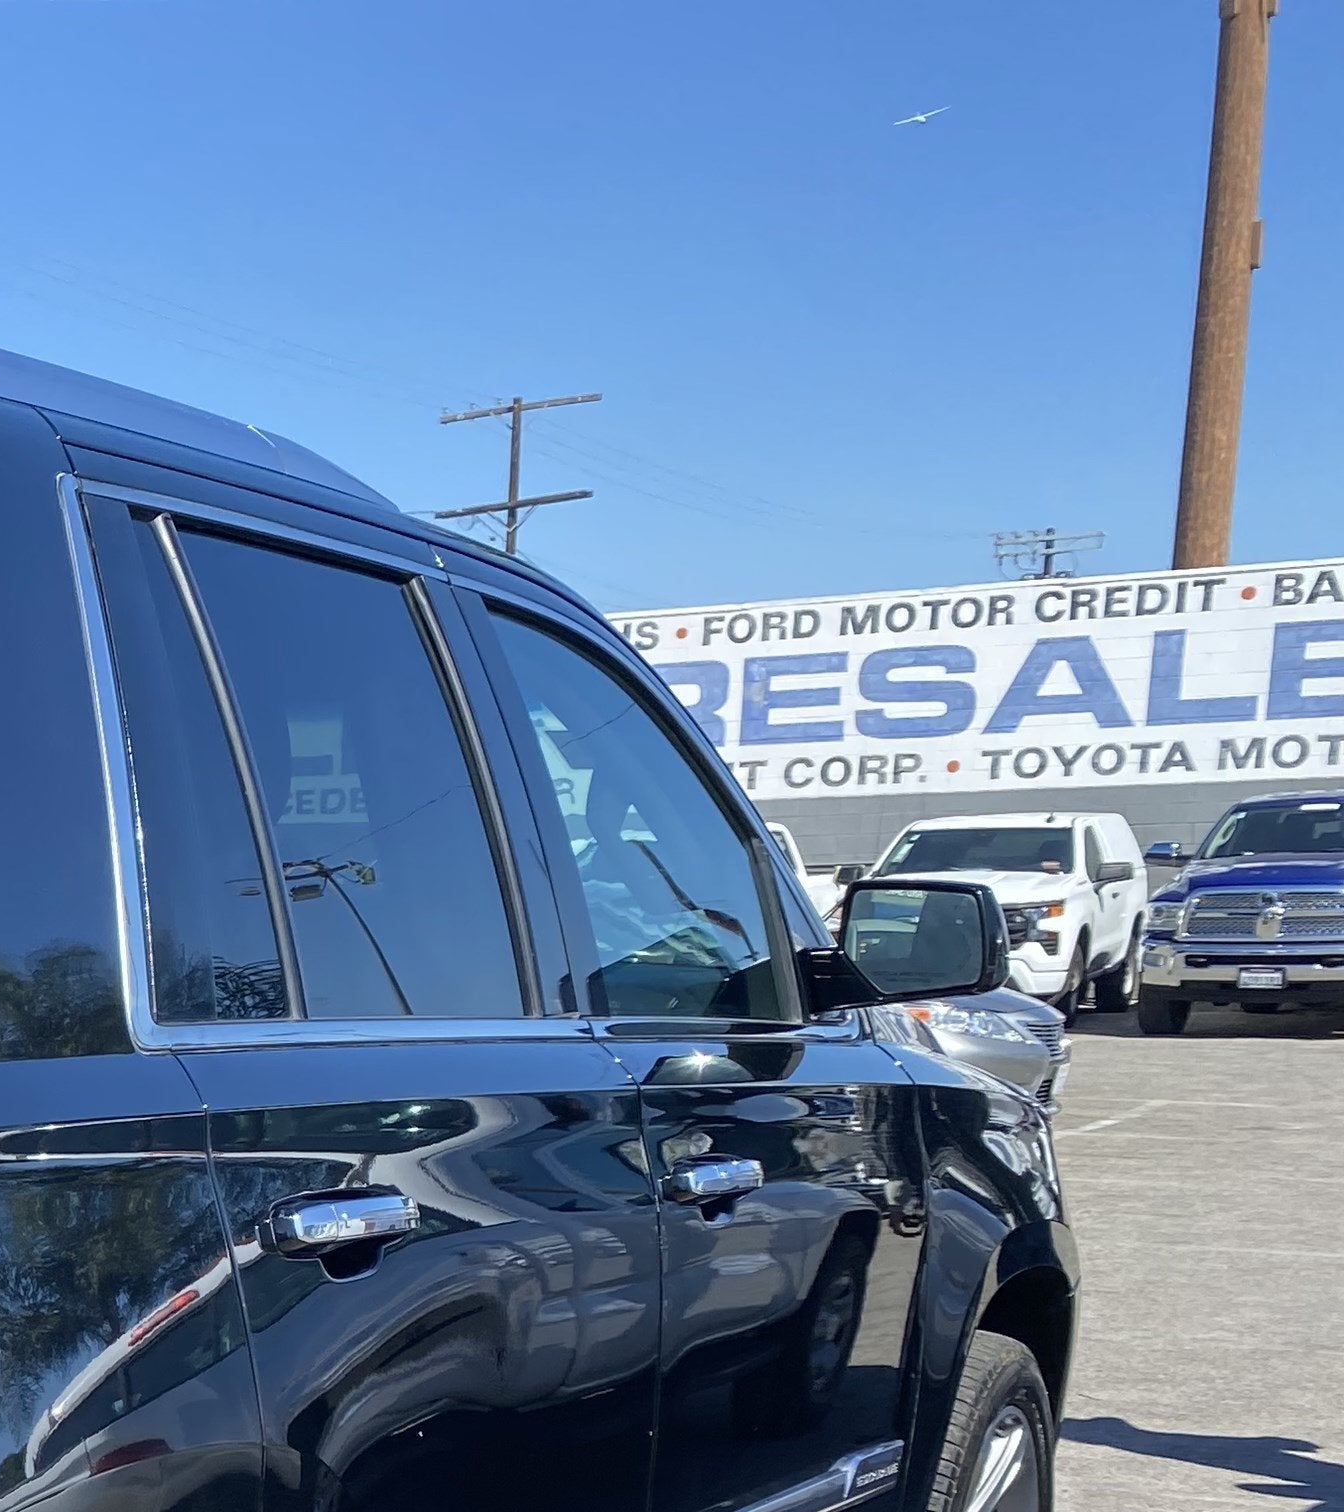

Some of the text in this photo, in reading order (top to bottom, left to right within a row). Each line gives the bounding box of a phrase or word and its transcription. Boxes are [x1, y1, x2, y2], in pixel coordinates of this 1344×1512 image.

[702, 608, 821, 646] FORD
[839, 594, 1016, 637] MOTOR
[1035, 578, 1227, 623] CREDIT
[1273, 569, 1344, 606] BA
[784, 753, 928, 789] CORP.
[981, 740, 1199, 780] TOYOTA
[1217, 734, 1344, 771] MOT
